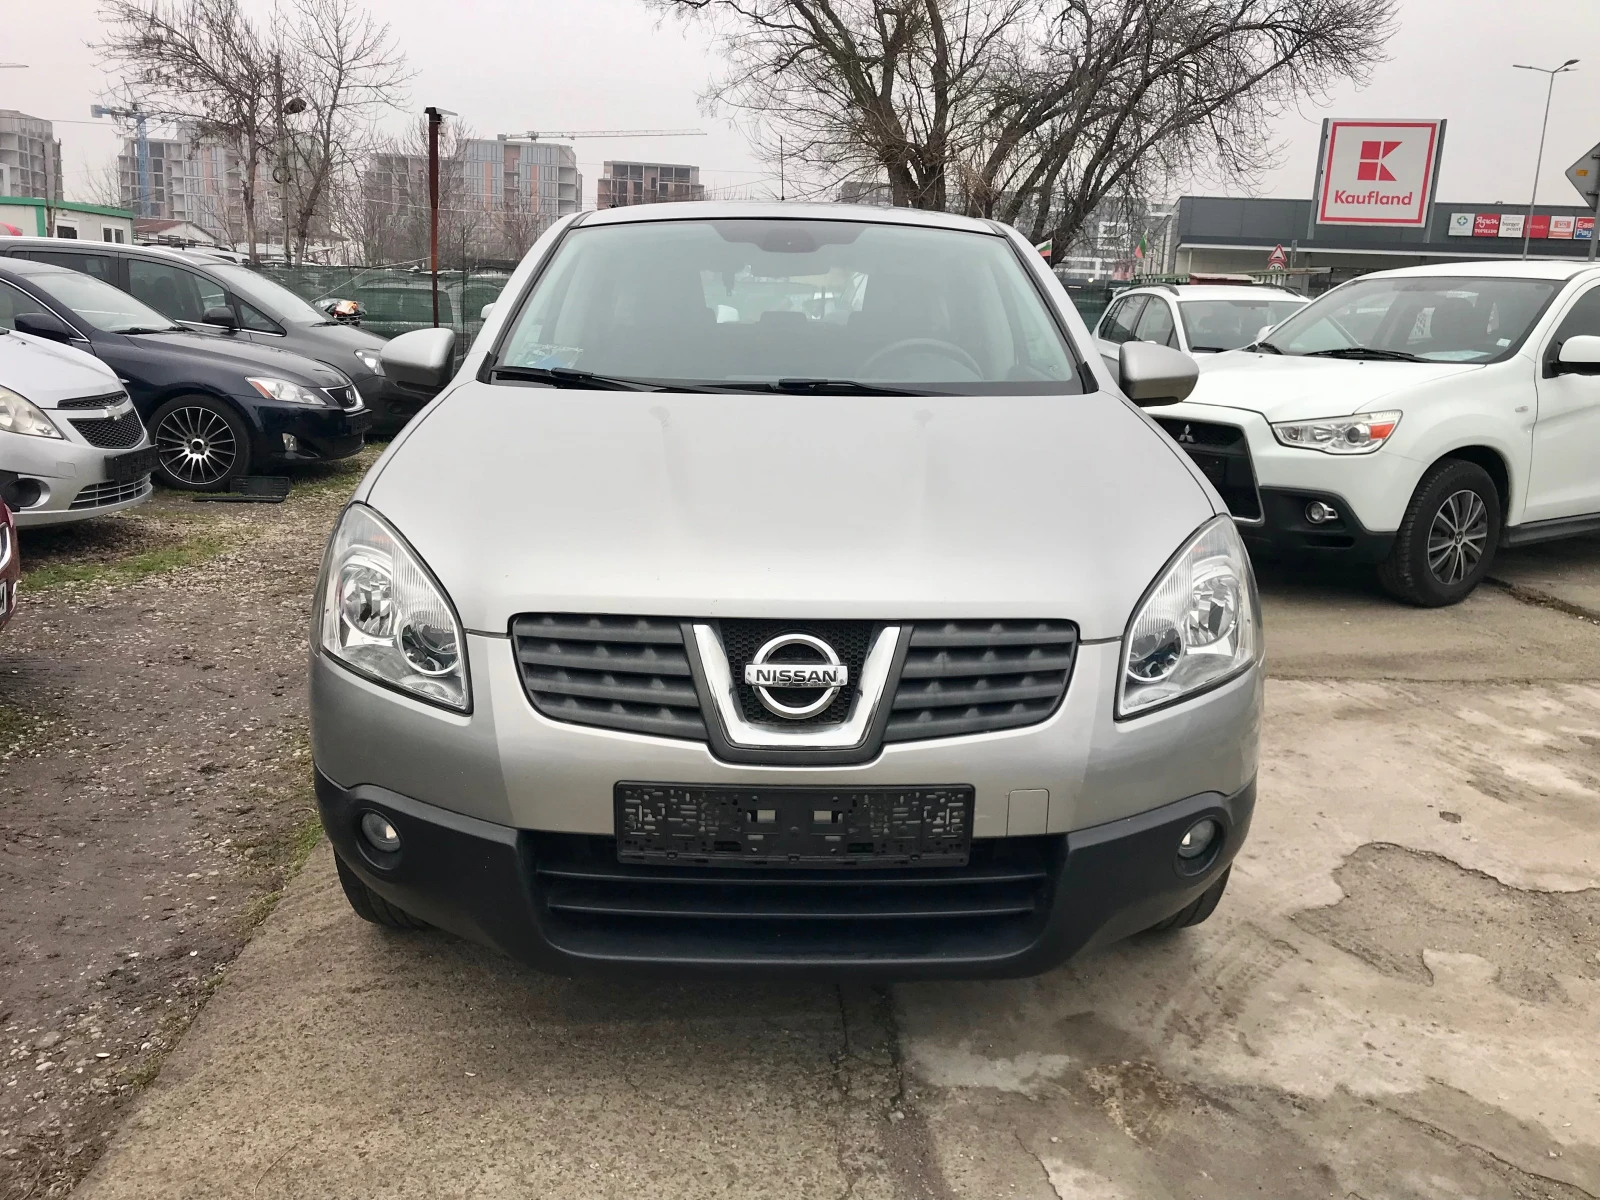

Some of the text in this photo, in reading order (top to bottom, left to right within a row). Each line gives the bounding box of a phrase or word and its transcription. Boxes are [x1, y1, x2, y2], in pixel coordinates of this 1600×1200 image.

[1334, 190, 1413, 206] Kaufland
[1578, 220, 1595, 229] Eas
[1576, 228, 1592, 238] Pay
[756, 669, 837, 682] NISSAN
